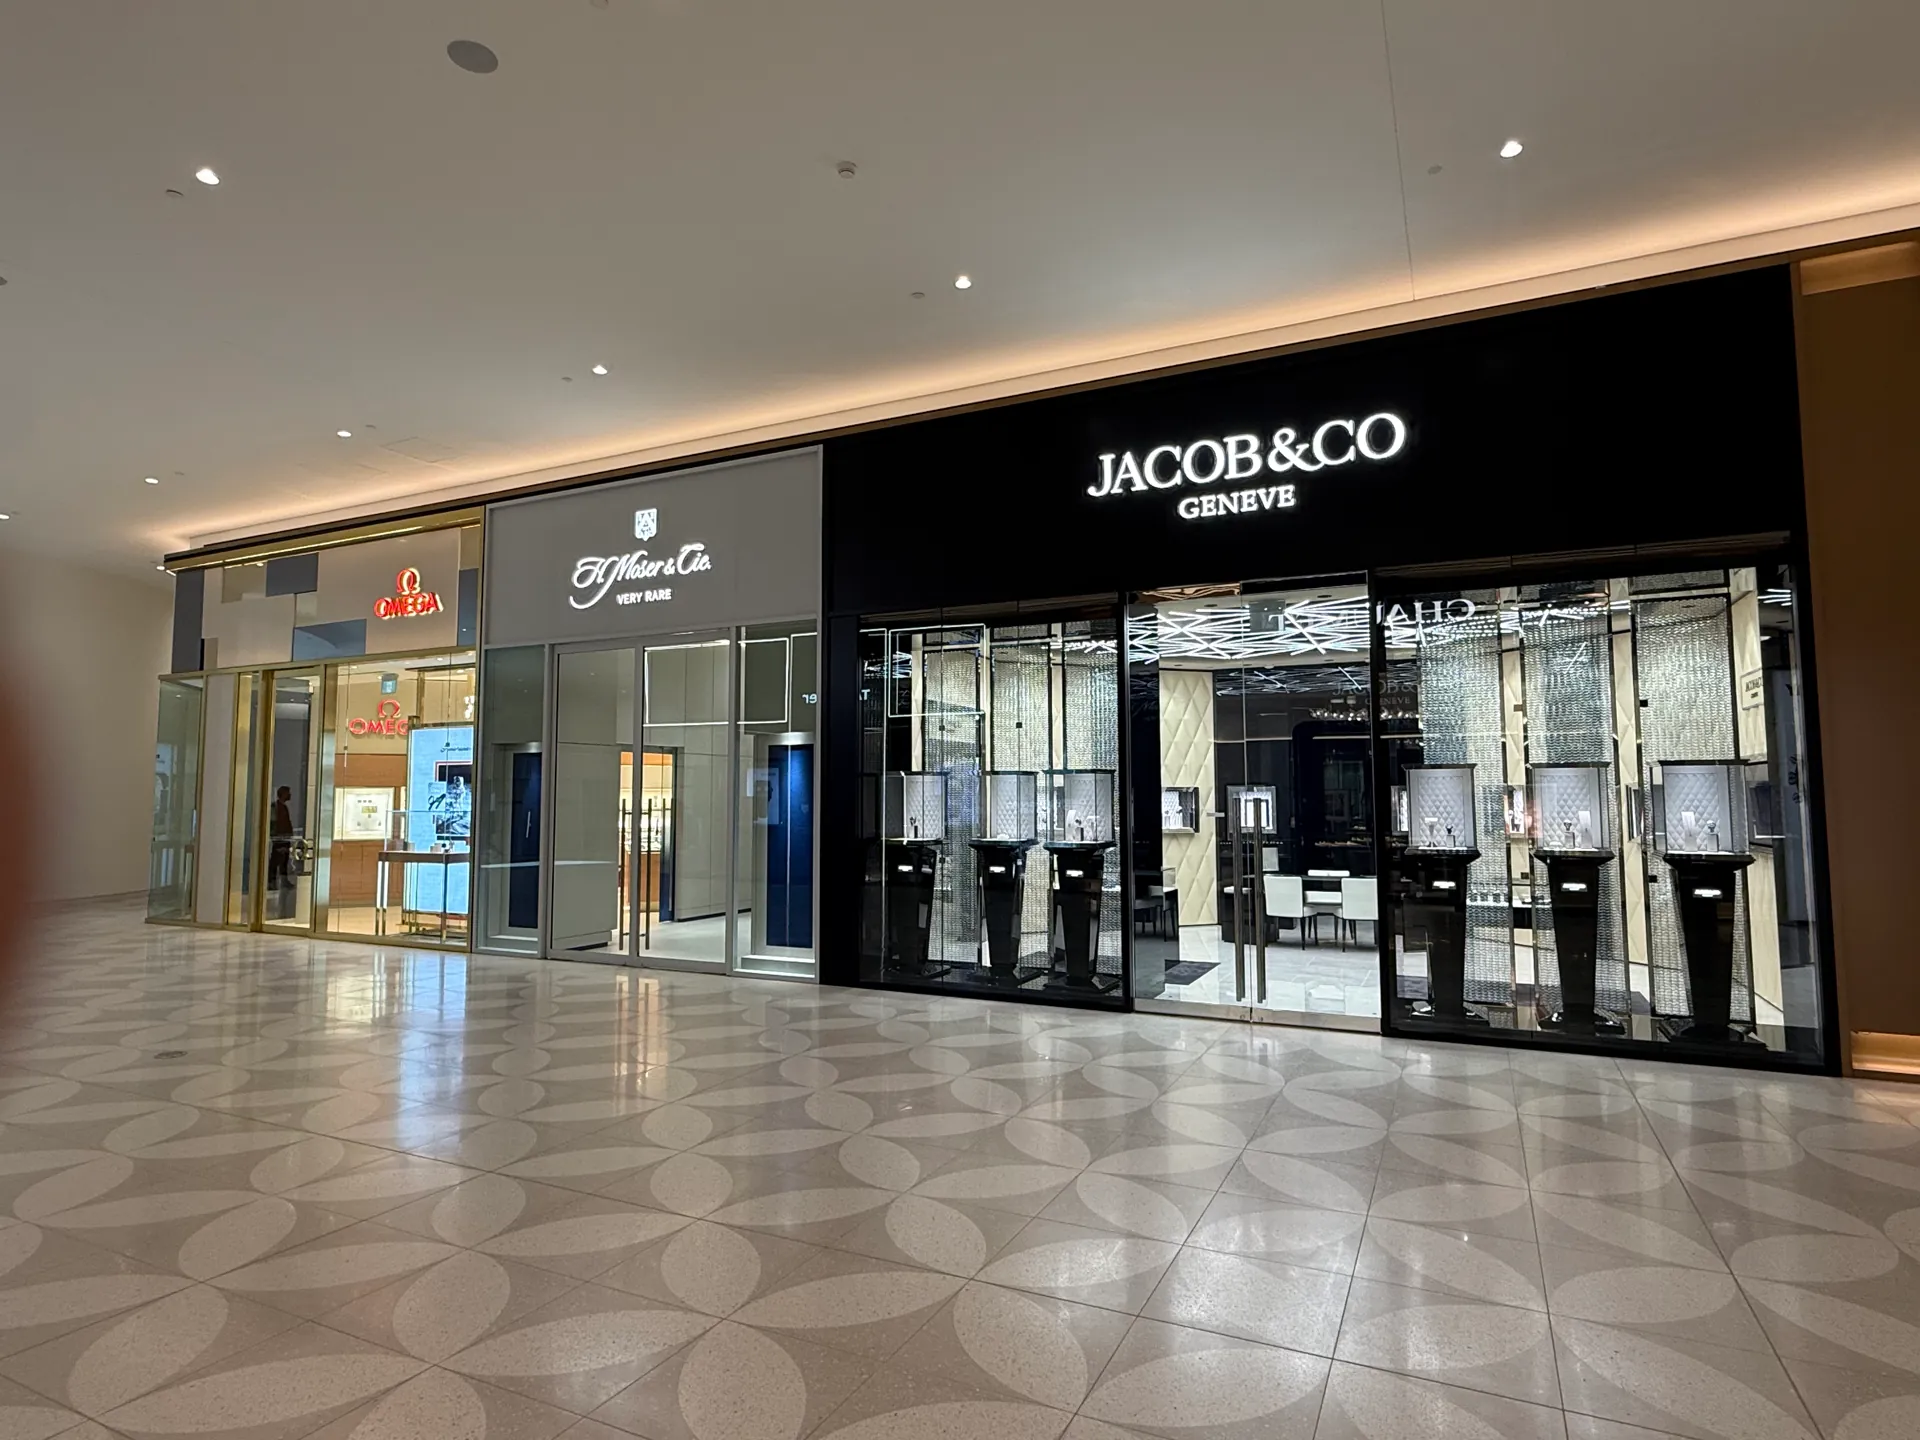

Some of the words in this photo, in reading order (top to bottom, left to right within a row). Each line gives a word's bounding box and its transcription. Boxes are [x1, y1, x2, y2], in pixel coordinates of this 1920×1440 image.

[1178, 485, 1296, 519] GENEVE
[664, 557, 676, 576] &
[374, 592, 443, 620] OMEGA
[616, 590, 644, 606] VERY
[645, 588, 671, 602] RARE
